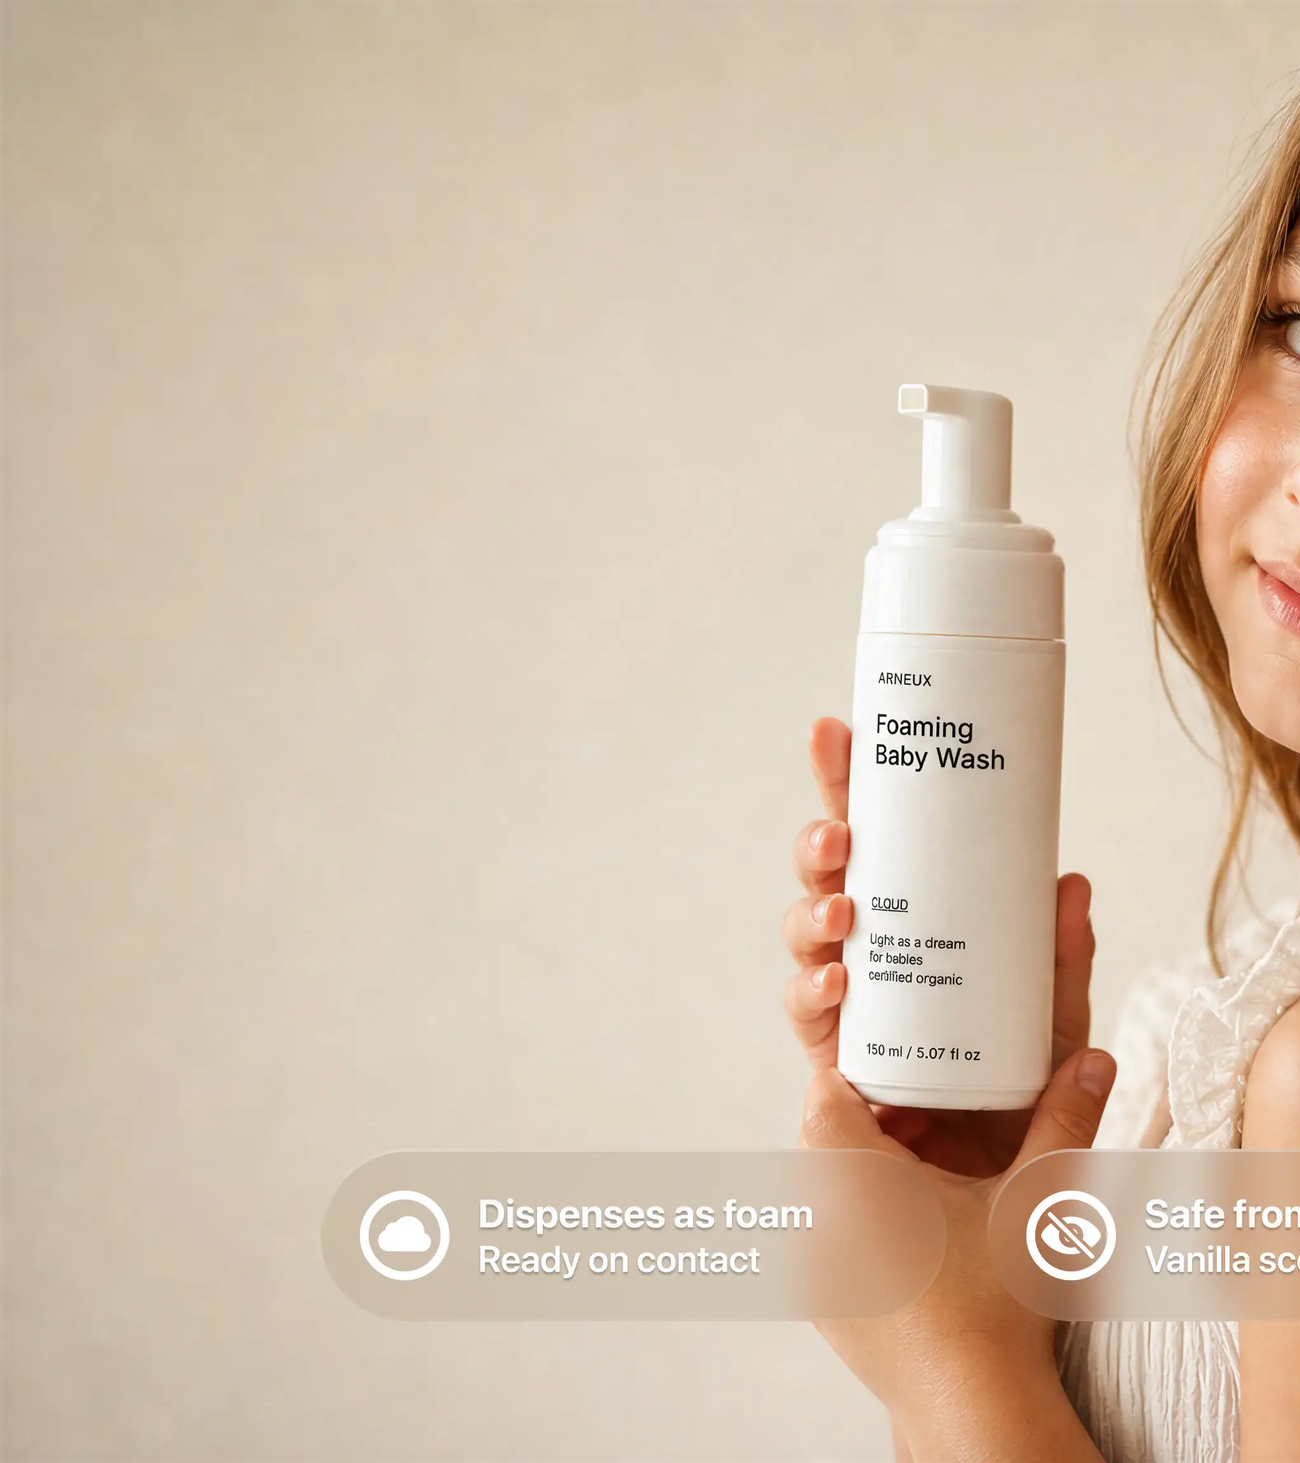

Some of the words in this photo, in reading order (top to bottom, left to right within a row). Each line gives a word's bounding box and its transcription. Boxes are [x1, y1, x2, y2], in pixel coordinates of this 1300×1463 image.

[878, 672, 932, 687] ARNEUX
[877, 713, 973, 744] Foaming
[876, 743, 928, 772] Baby
[936, 747, 1005, 770] Wash
[871, 896, 908, 913] CLOUD
[897, 937, 911, 947] as
[914, 938, 921, 948] a
[925, 937, 966, 950] dream
[869, 951, 883, 963] for
[916, 973, 963, 987] organic
[866, 1043, 885, 1056] 150
[888, 1046, 903, 1057] ml
[906, 1046, 912, 1060] /
[916, 1047, 945, 1060] 5.07
[950, 1048, 959, 1060] fl
[964, 1050, 981, 1061] oz
